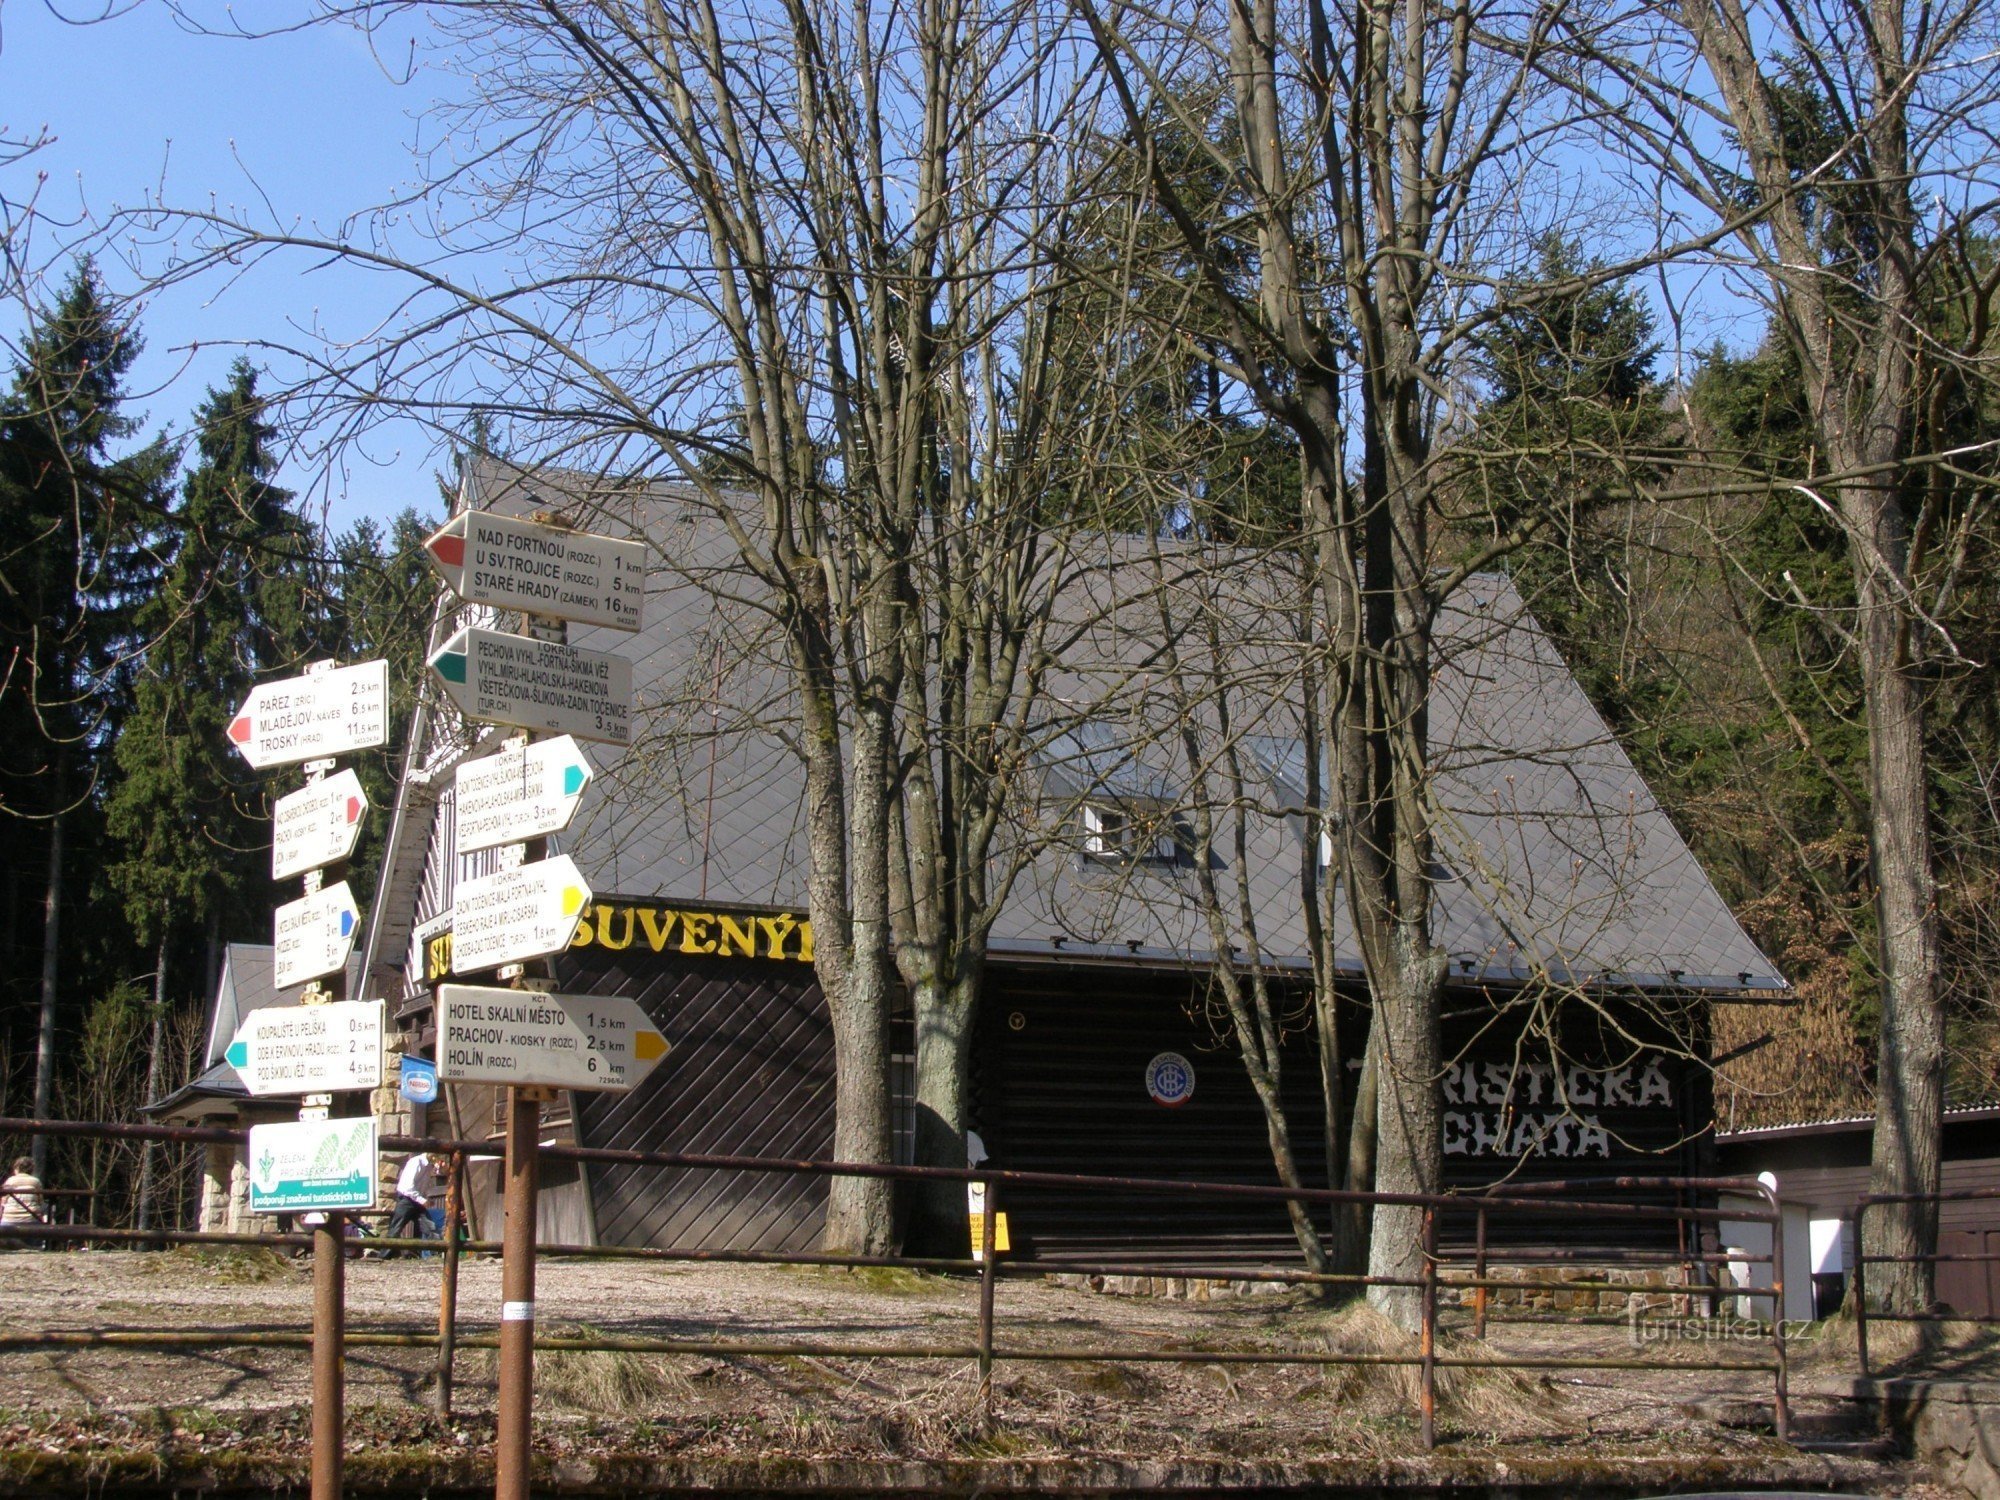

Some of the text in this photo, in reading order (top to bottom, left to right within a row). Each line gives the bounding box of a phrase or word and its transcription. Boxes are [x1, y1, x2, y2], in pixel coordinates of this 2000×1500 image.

[477, 528, 642, 574] NAD FORTNOU (ROZC.) 1 km
[476, 550, 640, 595] U SV.TROJICE (ROZC.) 5 km
[475, 572, 638, 616] STARÉ HRADY (ZÁMEK) 16 km
[478, 641, 514, 661] PECHOVA
[595, 662, 609, 680] VĚŽ
[260, 695, 290, 713] PAŘEZ
[367, 683, 379, 692] km
[260, 712, 312, 733] MLADĚJOV
[367, 703, 379, 712] km
[614, 721, 628, 734] km
[260, 734, 299, 752] TROSKY
[300, 733, 323, 747] (HRAD)
[367, 723, 380, 732] km
[547, 807, 557, 816] km
[546, 928, 556, 938] km
[364, 1021, 376, 1031] km
[450, 1004, 485, 1020] HOTEL
[487, 1006, 527, 1023] SKALNÍ
[529, 1008, 565, 1025] MĚSTO
[609, 1019, 625, 1029] km
[349, 1040, 356, 1053] 2
[364, 1042, 376, 1052] km
[449, 1027, 503, 1044] PRACHOV
[510, 1035, 546, 1047] KIOSKY
[549, 1038, 577, 1051] (ROZC.)
[609, 1041, 625, 1051] km
[364, 1064, 376, 1074] km
[449, 1049, 624, 1073] HOLÍN (ROZC.) 6 km
[254, 1190, 368, 1207] podporují značení turistických tras
